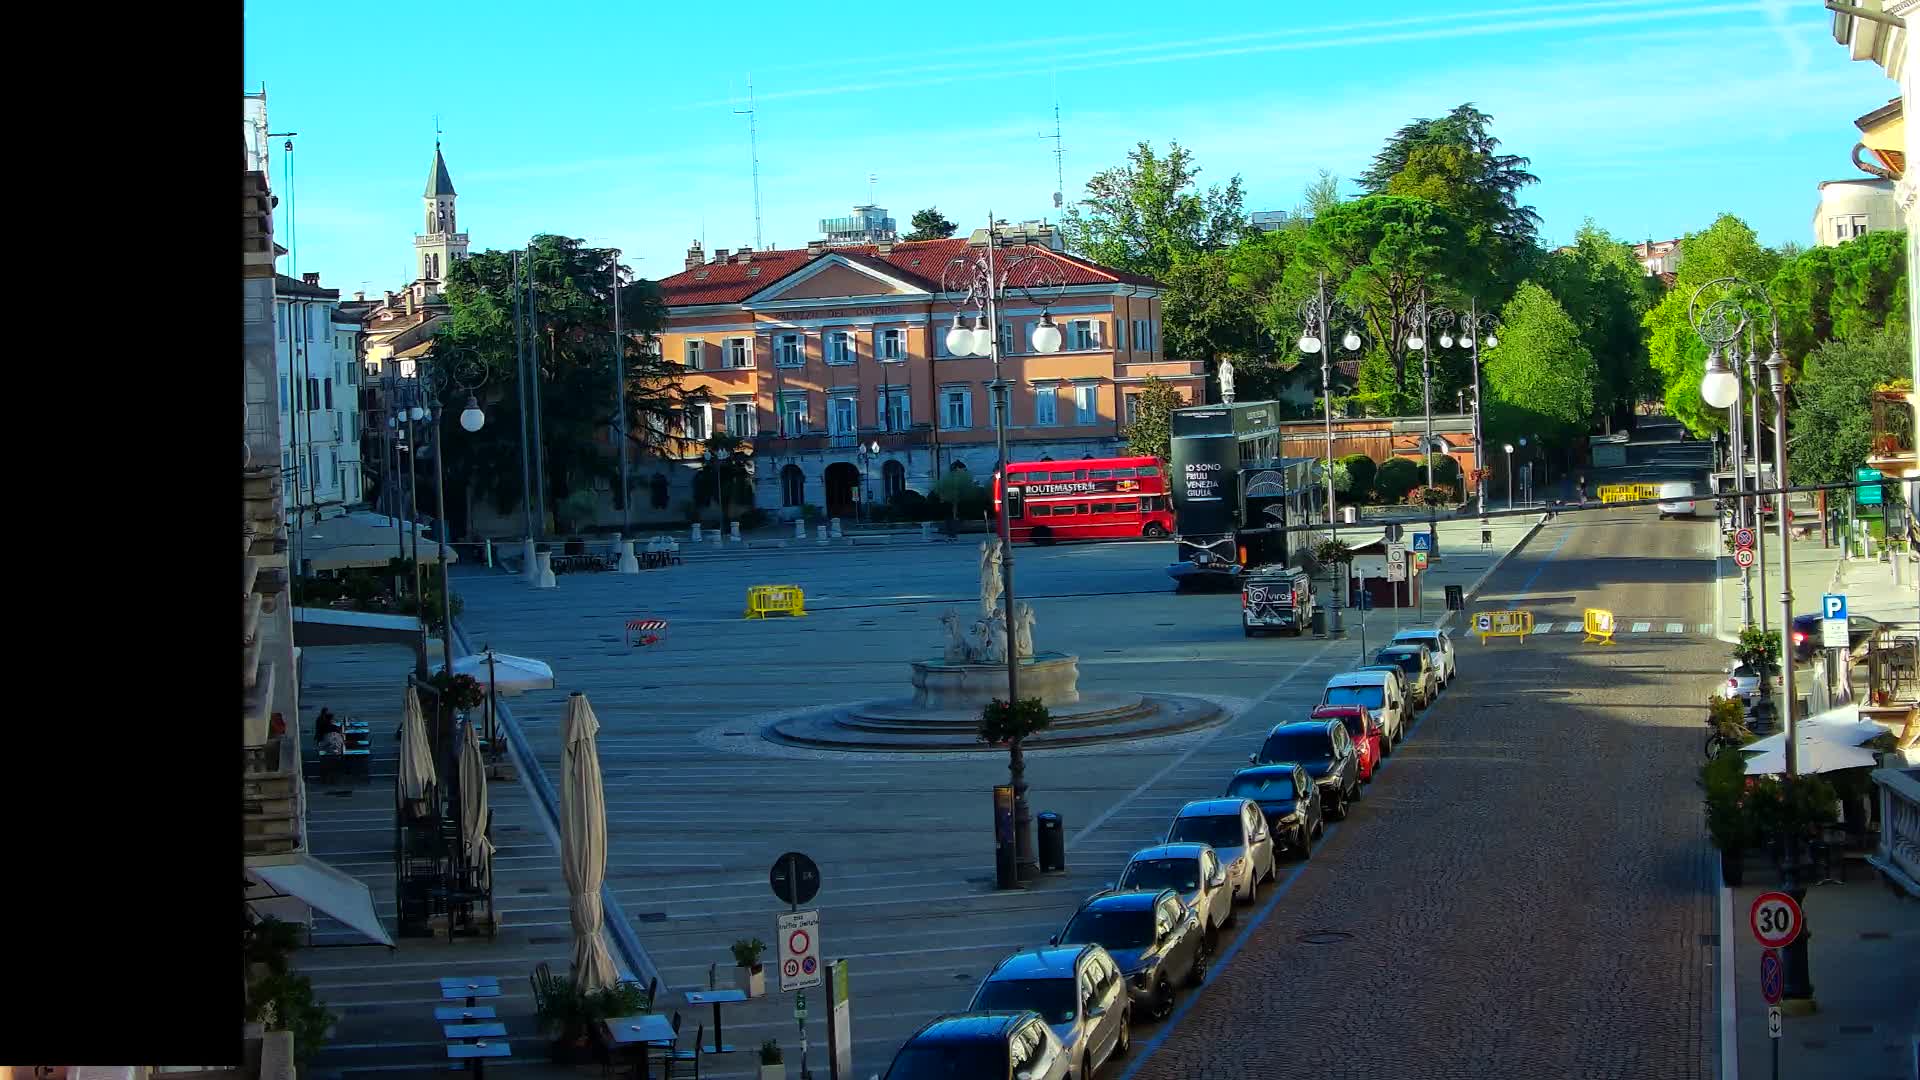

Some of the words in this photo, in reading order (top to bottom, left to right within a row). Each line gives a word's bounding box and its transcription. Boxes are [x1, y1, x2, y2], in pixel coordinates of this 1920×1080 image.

[775, 311, 817, 321] PALZZO
[1185, 463, 1195, 472] IO
[1196, 463, 1222, 472] SONO
[1185, 472, 1208, 480] FRIULI
[1185, 480, 1219, 489] VENEZIA
[1186, 488, 1213, 497] GIULIA
[1740, 553, 1751, 563] 20
[1827, 597, 1842, 618] P
[1759, 906, 1790, 934] 30
